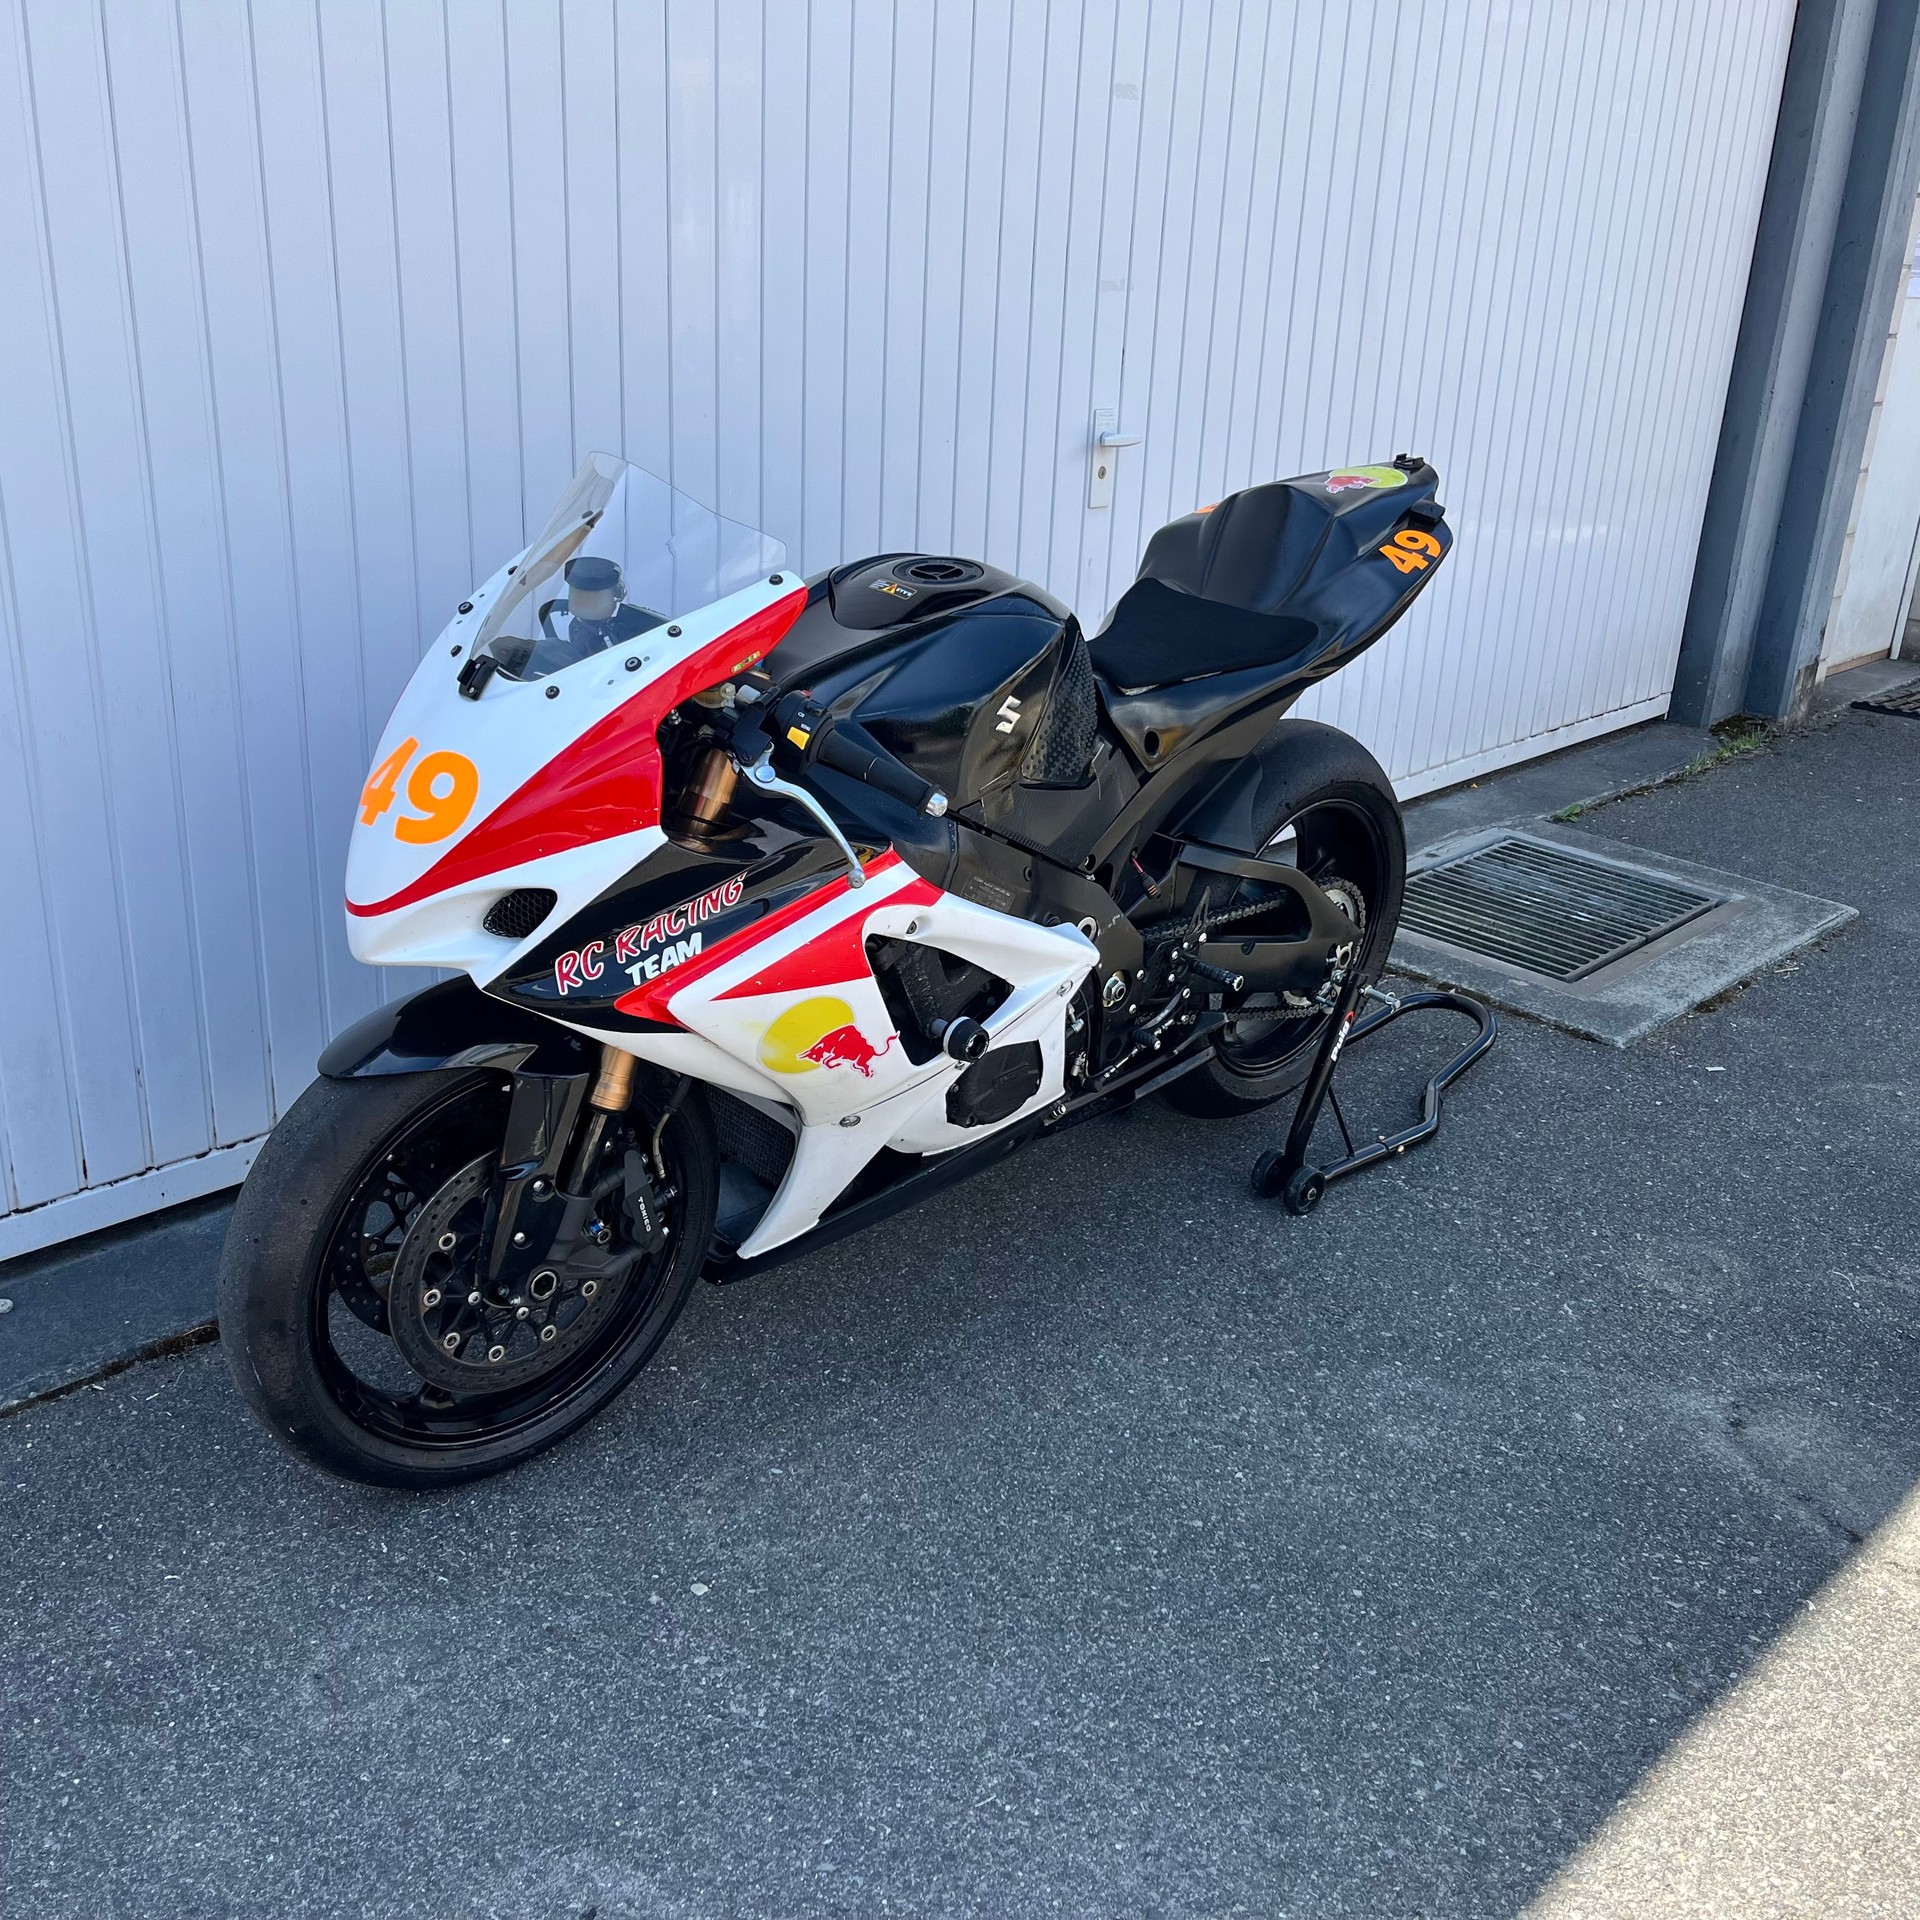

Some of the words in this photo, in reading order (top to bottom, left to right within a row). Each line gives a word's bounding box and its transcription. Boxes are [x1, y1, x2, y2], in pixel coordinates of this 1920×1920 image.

[1379, 529, 1441, 575] 49
[359, 736, 480, 845] 49
[555, 941, 604, 996] RC
[616, 871, 749, 963] RACING
[624, 932, 703, 986] TEAM
